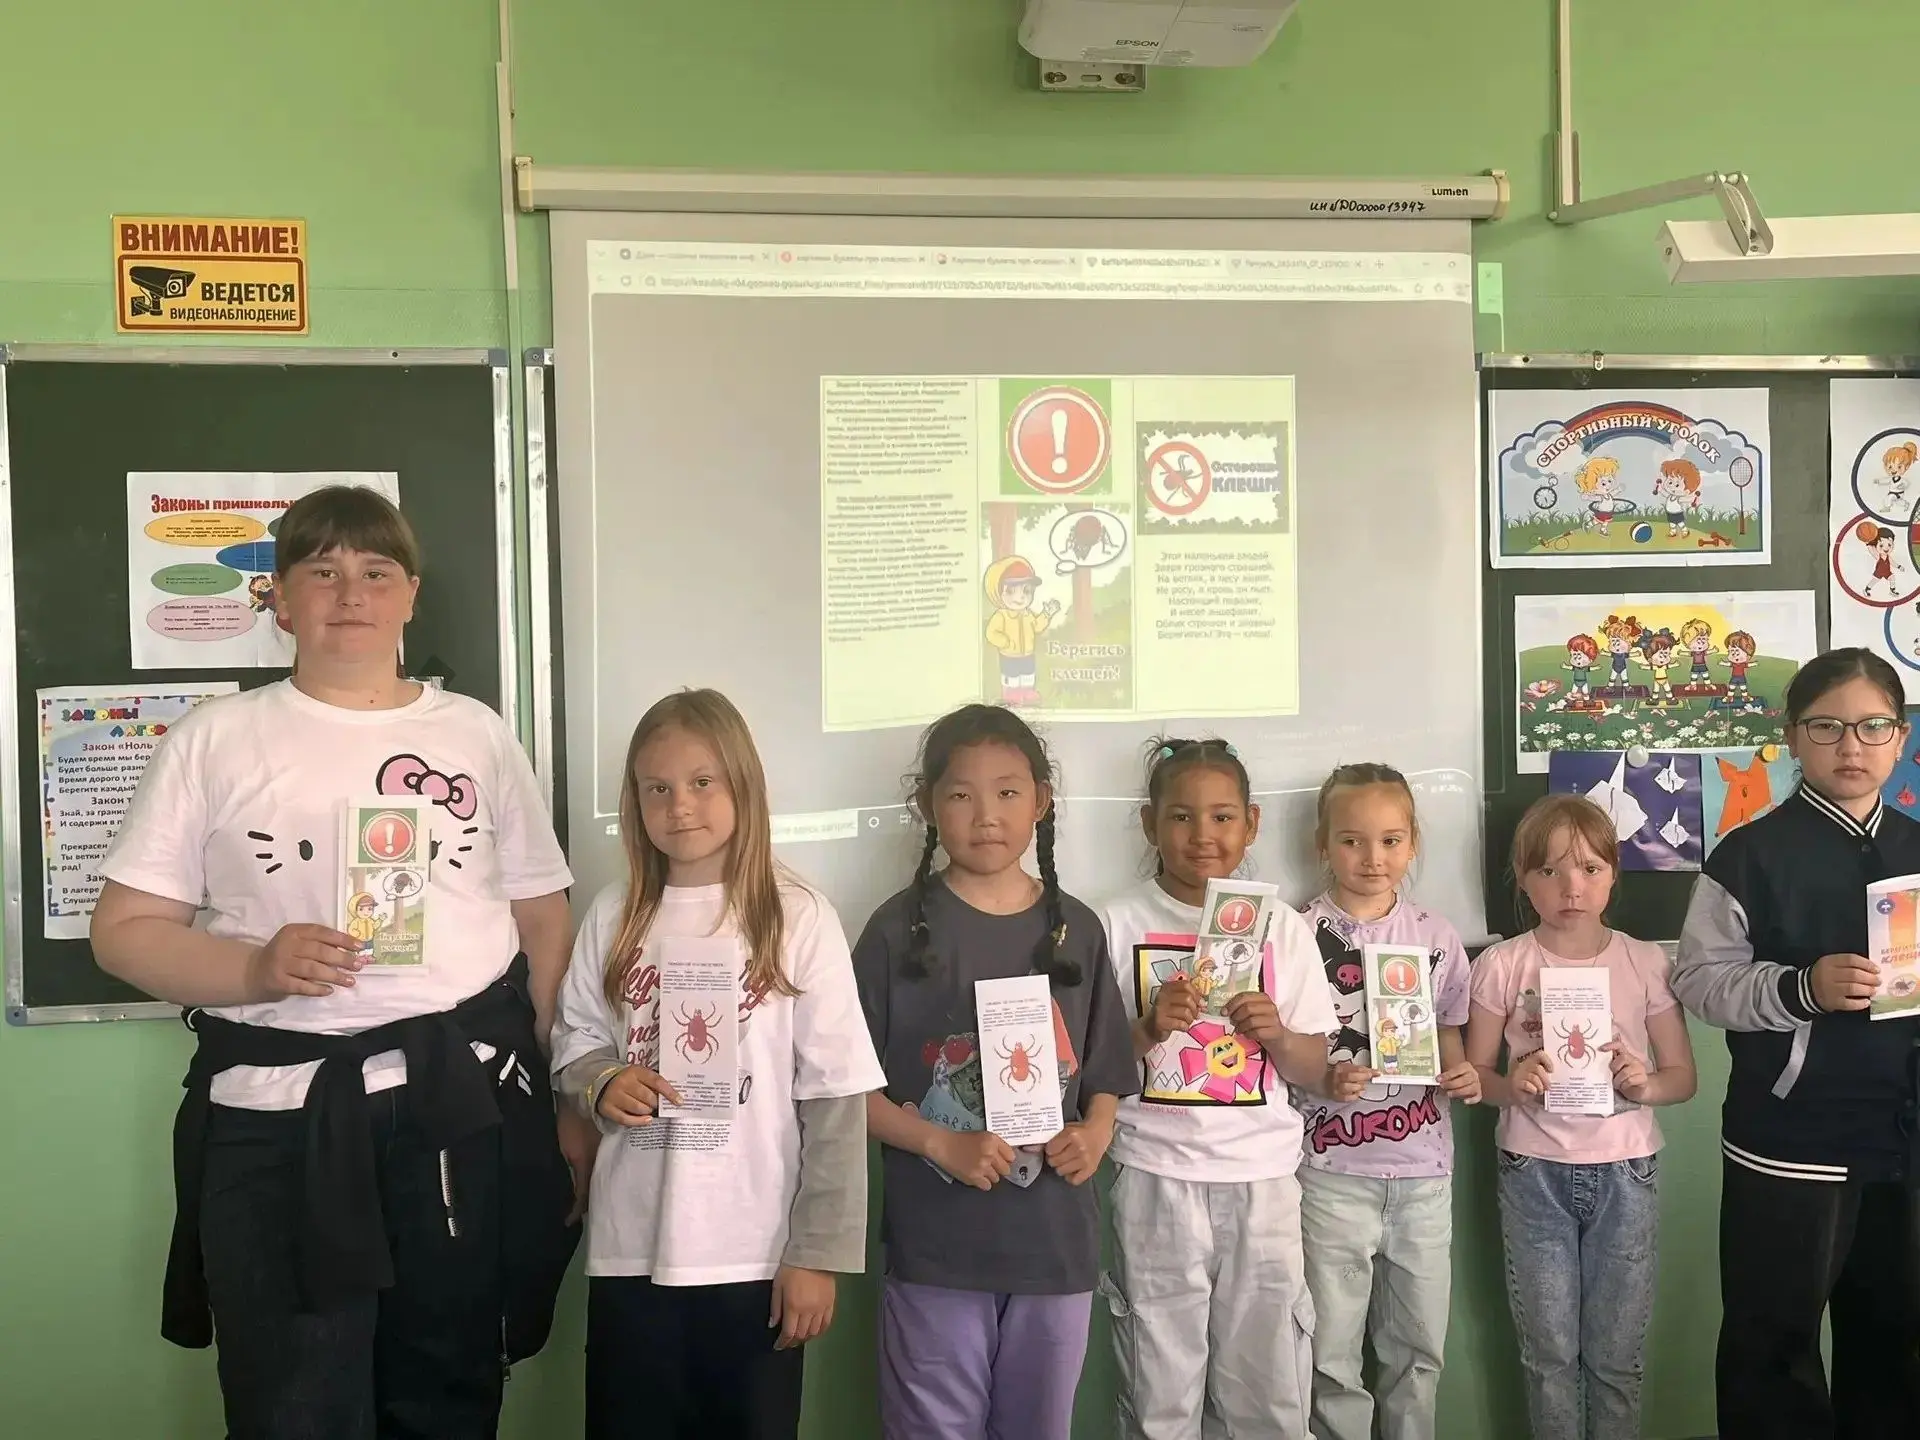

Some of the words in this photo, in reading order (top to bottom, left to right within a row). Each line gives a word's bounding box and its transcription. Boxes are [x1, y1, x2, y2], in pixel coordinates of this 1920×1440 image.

[1115, 39, 1159, 47] EPSON
[120, 223, 299, 254] ВНИМАНИЕ!
[201, 282, 295, 305] ВЕДЕТСЯ
[170, 307, 297, 322] ВИДЕОНАБЛЮДЕНИЕ
[1537, 412, 1652, 467] СПОРТИВНЫЙ
[1657, 418, 1721, 464] УГОЛОК
[151, 493, 210, 513] Законы
[1047, 640, 1125, 659] Берегись
[1050, 665, 1120, 683] клещей!
[61, 708, 139, 722] ЗАКОНЫ
[82, 743, 115, 752] Закон
[118, 742, 153, 751] «Ноль
[58, 756, 87, 764] Будем
[87, 755, 115, 763] время
[58, 766, 84, 774] Будет
[85, 765, 118, 773] больше
[58, 776, 87, 784] Время
[89, 776, 120, 784] дорого
[100, 784, 136, 792] каждый
[91, 797, 124, 805] Закон
[69, 820, 108, 828] содержи
[60, 843, 108, 852] Прекрасен
[70, 887, 99, 895] лагере
